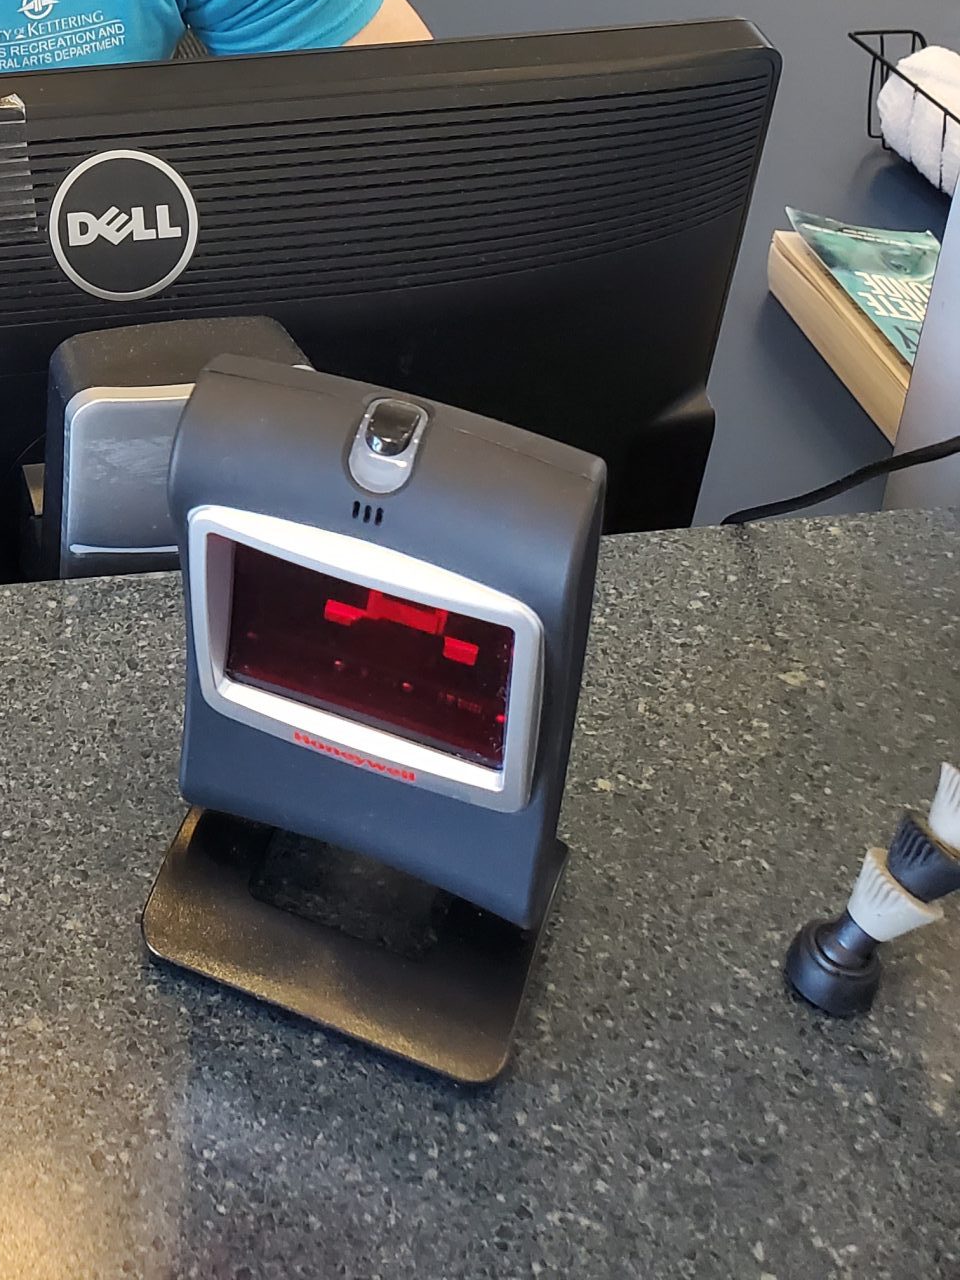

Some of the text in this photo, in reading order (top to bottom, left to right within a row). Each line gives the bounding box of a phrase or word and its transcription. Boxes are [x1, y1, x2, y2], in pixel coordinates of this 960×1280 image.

[10, 32, 96, 57] RECREATION
[99, 23, 125, 39] AND
[27, 9, 104, 37] KETTERING
[22, 52, 52, 67] ARTS
[55, 35, 126, 62] DEPARTMENT
[66, 204, 183, 247] DELL
[293, 731, 416, 783] Honeywell
